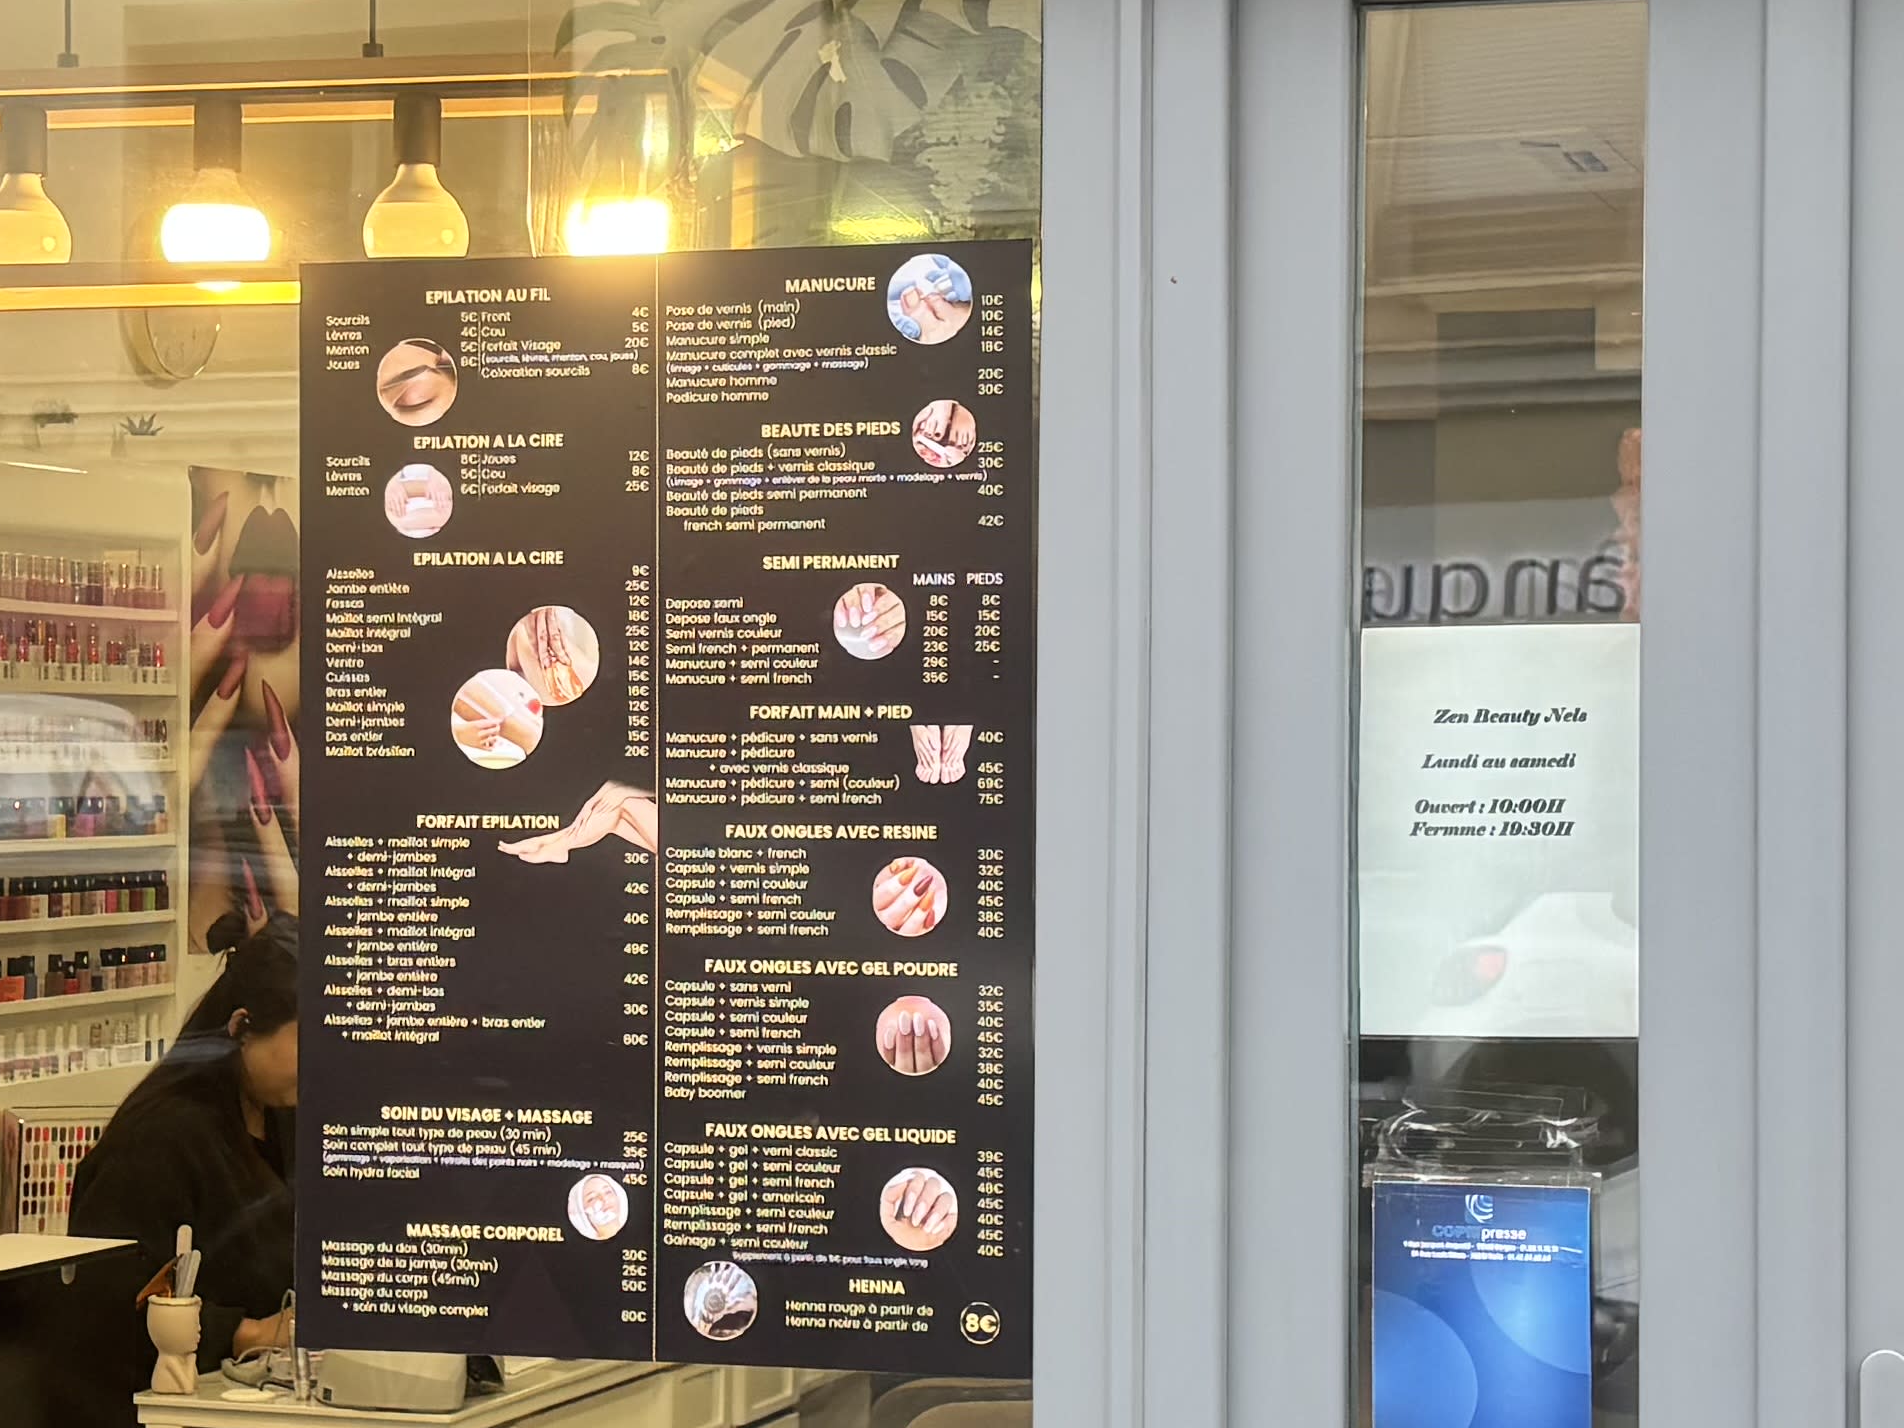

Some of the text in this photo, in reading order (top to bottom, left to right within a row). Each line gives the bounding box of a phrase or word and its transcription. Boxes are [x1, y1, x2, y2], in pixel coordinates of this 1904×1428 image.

[784, 277, 875, 293] MANUCURE
[425, 287, 551, 304] EPILATION AU FIL
[980, 294, 1003, 306] 10€
[325, 314, 370, 326] Sourcils
[631, 306, 648, 318] 4€
[980, 325, 1003, 336] 14€
[631, 363, 649, 375] 8€
[977, 368, 1003, 380] 20€
[760, 421, 900, 438] BEAUTE DES PIEDS
[413, 433, 564, 449] EPILATION A LA CIRE
[977, 441, 1004, 453] 25€
[631, 465, 650, 477] 8€
[977, 515, 1004, 527] 42€
[412, 550, 563, 566] EPILATION A LA CIRE
[762, 554, 900, 570] SEMI PERMANENT
[912, 572, 1003, 586] MAINS PIEDS
[925, 610, 948, 622] 15€
[977, 609, 1000, 621] 15€
[922, 625, 948, 637] 20€
[974, 624, 1000, 637] 20€
[922, 640, 1000, 653] 23€ 25€
[627, 655, 649, 666] 14€
[749, 705, 815, 719] FORFAIT
[817, 705, 860, 719] MAIN
[876, 705, 912, 719] PIED
[1433, 709, 1469, 724] Zen
[1473, 708, 1541, 726] Beauty
[977, 762, 1003, 774] 45€
[1421, 753, 1576, 769] Lundi au samedi
[1414, 799, 1476, 814] Ouvert
[1488, 799, 1566, 814] 10:00H
[416, 814, 559, 829] FORFAIT EPILATION
[1409, 821, 1487, 836] Fermme
[724, 824, 937, 839] FAUX ONGLES AVEC RESINE
[623, 852, 649, 864] 30€
[977, 848, 1004, 861] 30€
[977, 895, 1003, 907] 45€
[977, 910, 1004, 923] 38€
[704, 958, 958, 977] FAUX ONGLES AVEC GEL POUDRE
[977, 1000, 1003, 1012] 35€
[976, 1093, 1003, 1106] 45€
[380, 1106, 418, 1121] SOIN
[420, 1106, 443, 1121] DU
[445, 1107, 502, 1122] VISAGE
[516, 1109, 592, 1124] MASSAGE
[622, 1131, 648, 1143] 25€
[704, 1122, 956, 1144] FAUX ONGLES AVEC GEL LIQUIDE
[976, 1150, 1003, 1163] 39€
[405, 1223, 564, 1242] MASSAGE CORPOREL
[848, 1279, 905, 1294] HENNA
[964, 1313, 997, 1333] 8€
